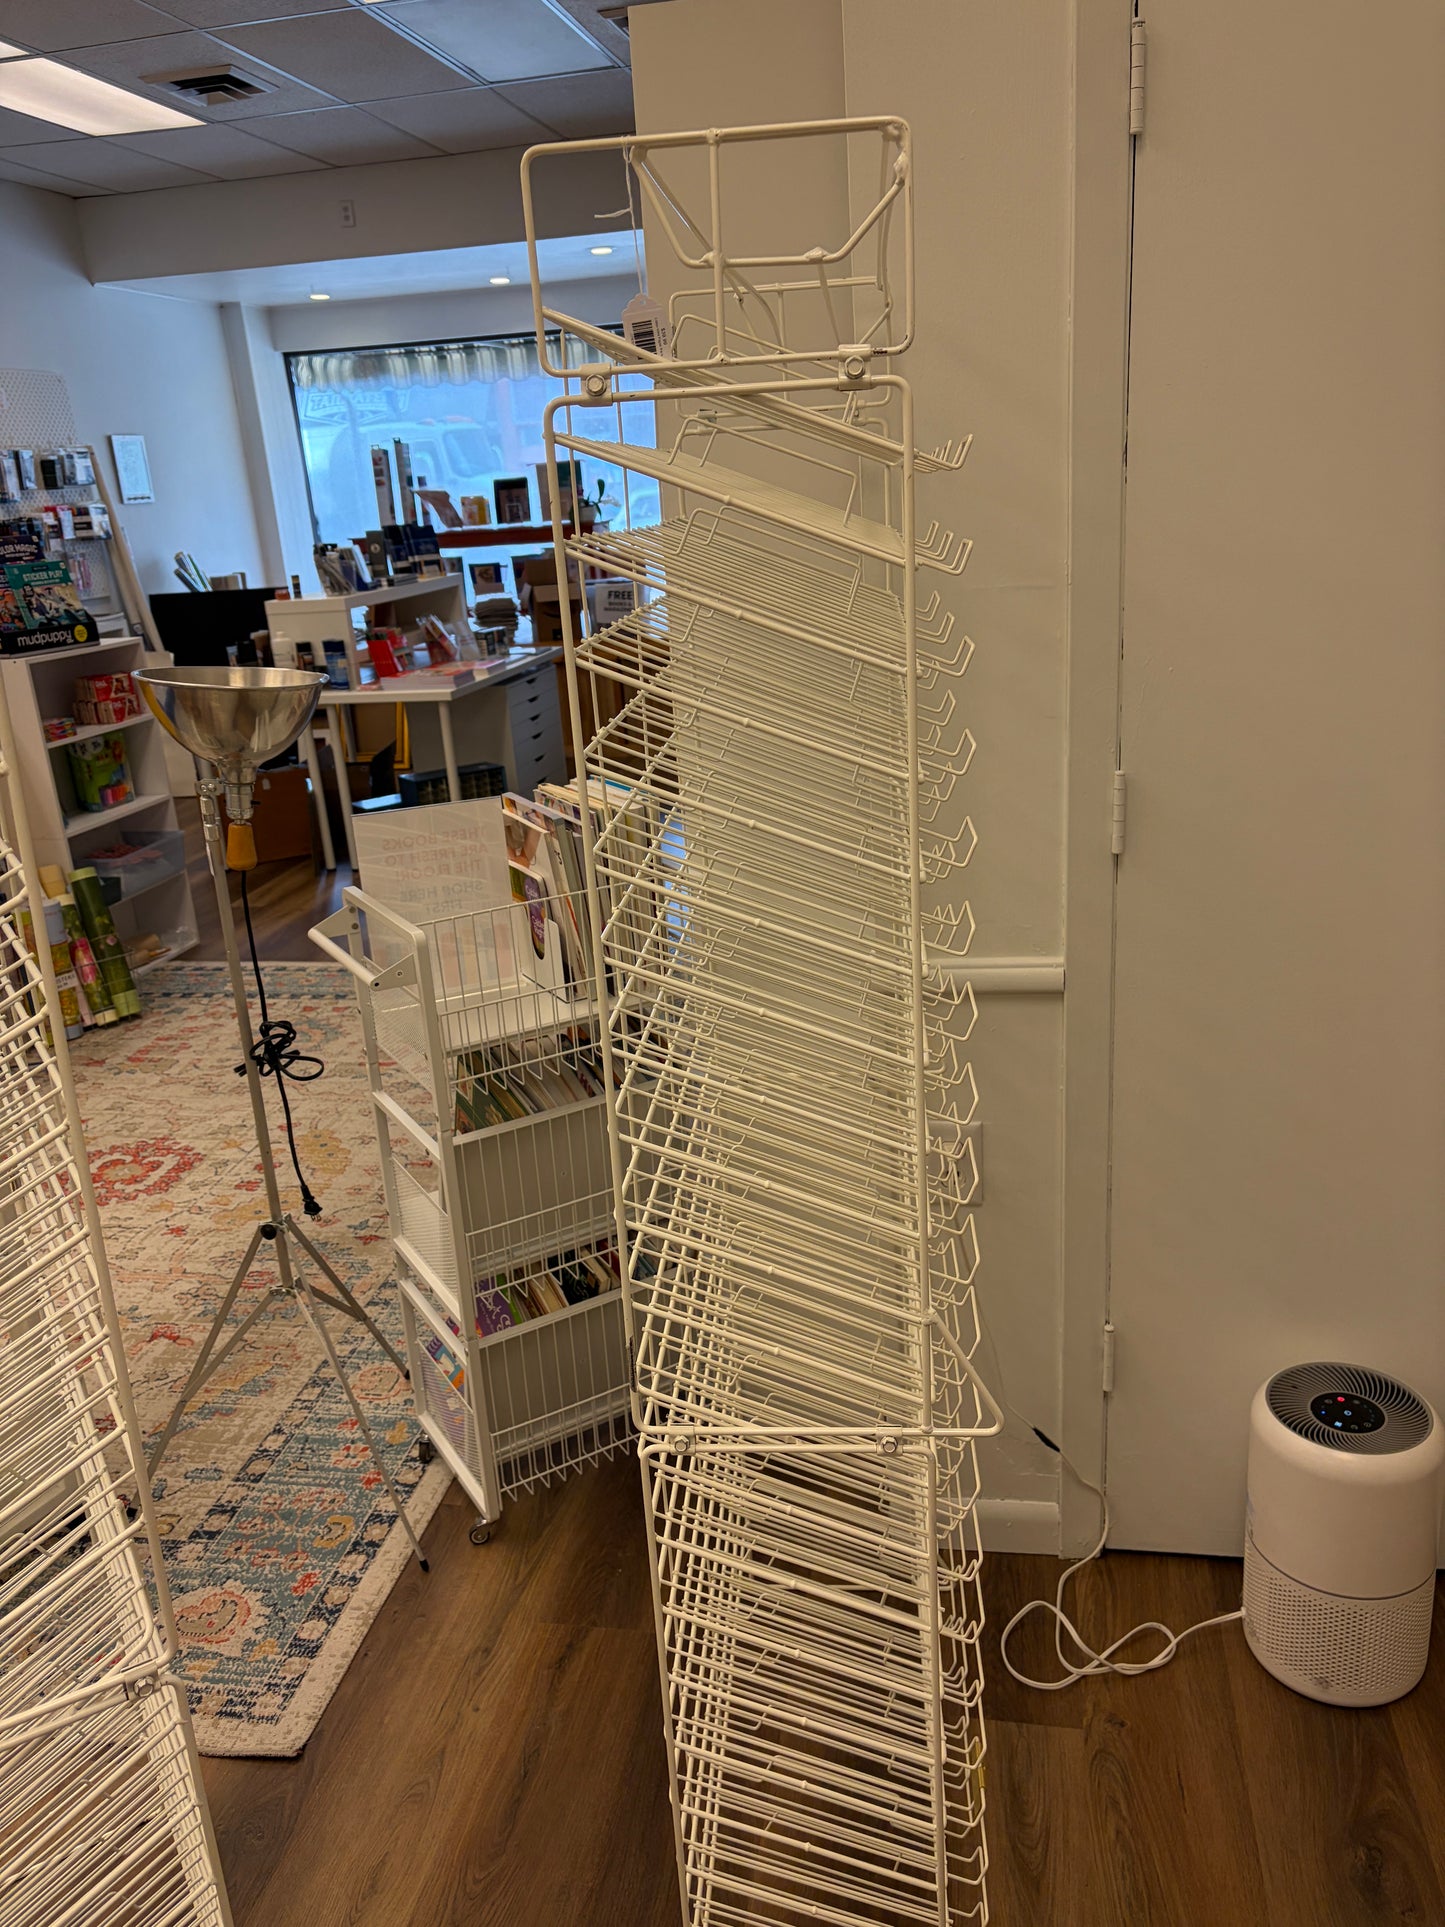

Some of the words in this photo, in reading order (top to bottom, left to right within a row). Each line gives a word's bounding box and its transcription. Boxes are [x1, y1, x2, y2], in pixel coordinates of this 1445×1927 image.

[23, 571, 48, 582] STICKER
[607, 591, 632, 600] FREE
[17, 630, 72, 647] mudpuppy
